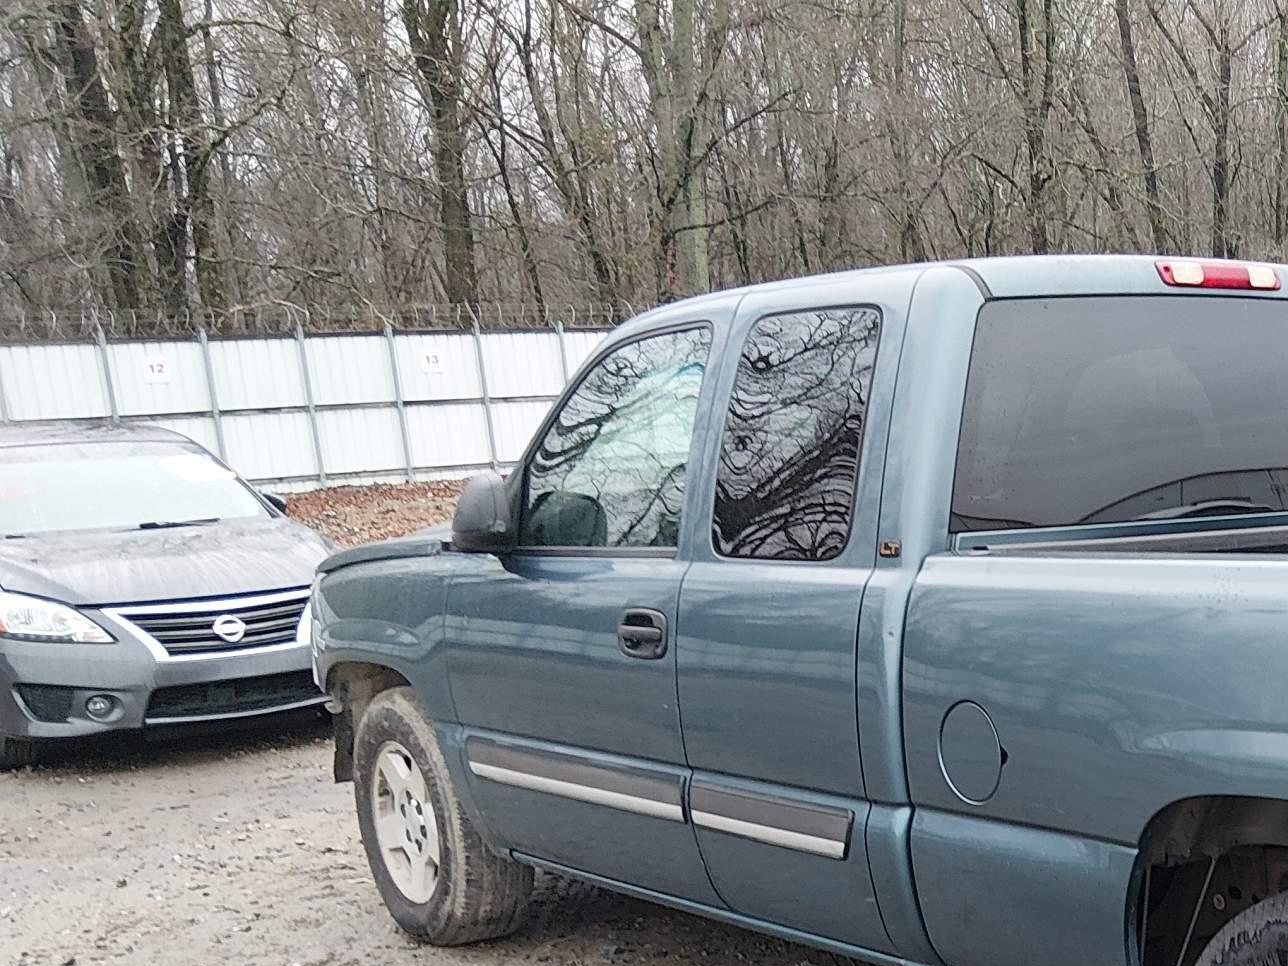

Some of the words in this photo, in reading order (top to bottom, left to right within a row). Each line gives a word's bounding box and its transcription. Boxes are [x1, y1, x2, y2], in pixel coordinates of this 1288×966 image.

[425, 354, 439, 366] 13
[149, 363, 165, 374] 12
[880, 541, 900, 556] LT
